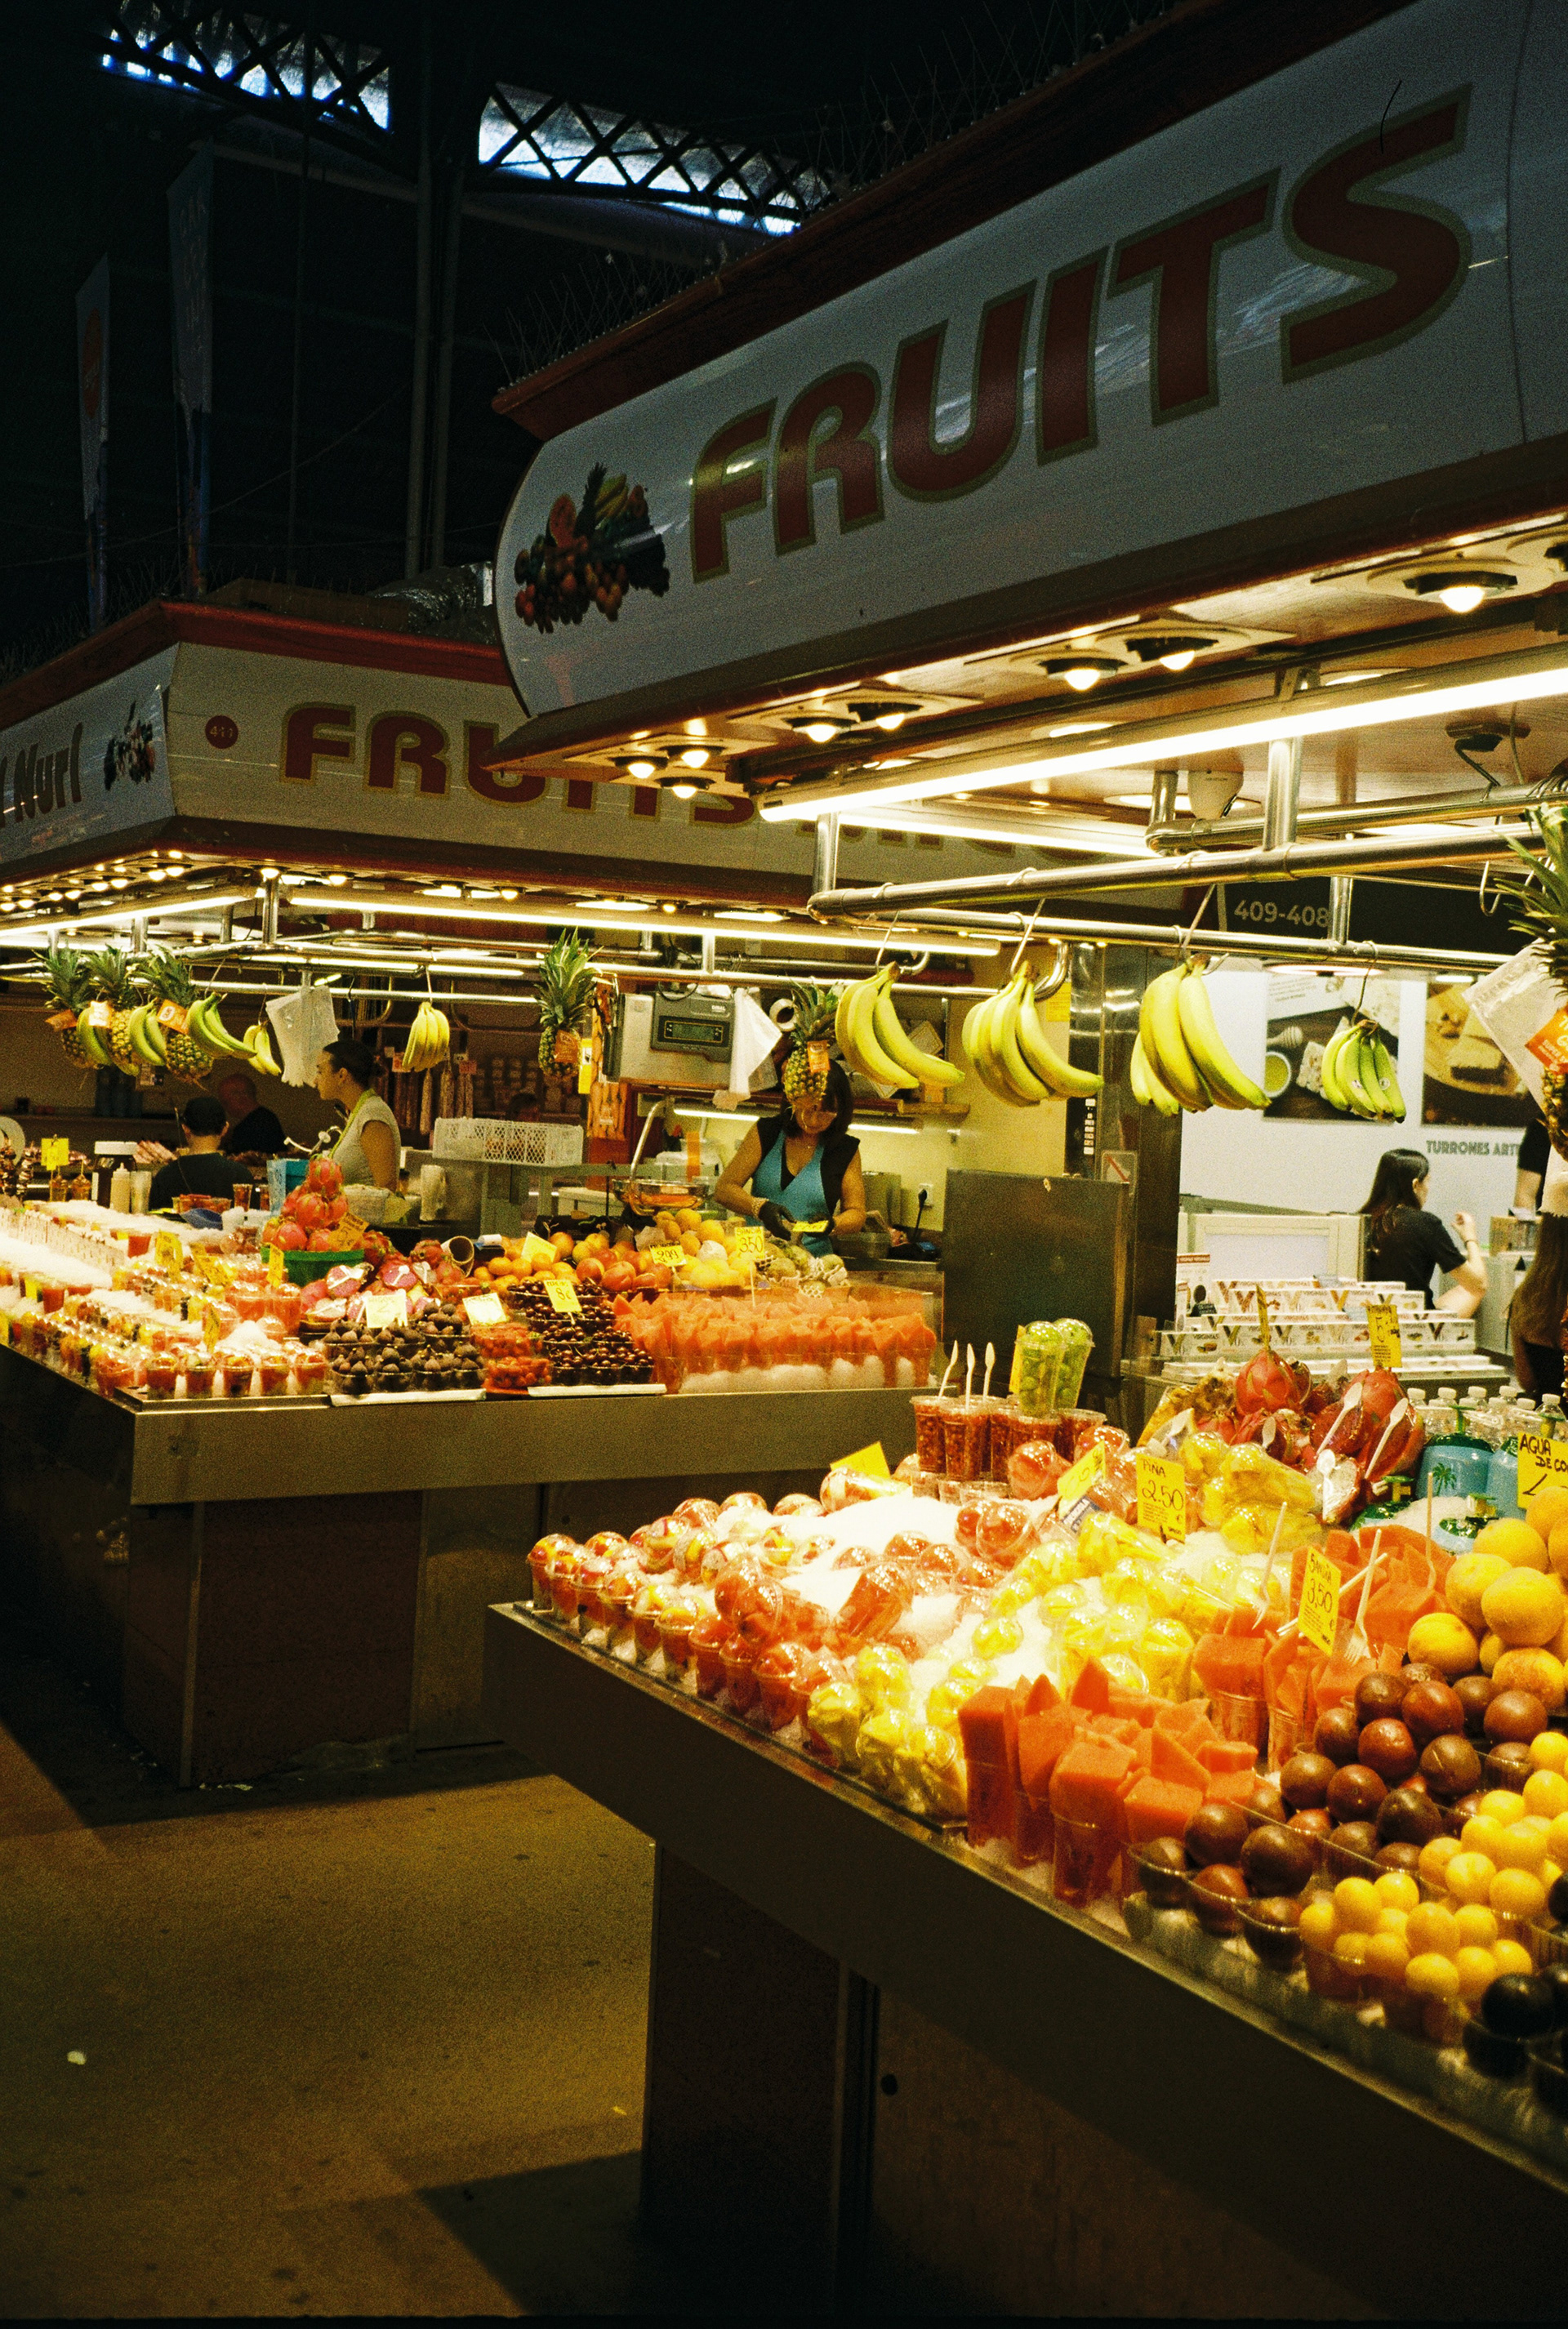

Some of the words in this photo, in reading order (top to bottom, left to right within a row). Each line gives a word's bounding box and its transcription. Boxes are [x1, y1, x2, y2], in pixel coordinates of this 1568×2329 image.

[690, 82, 1474, 583] FRUITS
[1233, 899, 1330, 928] 409-408
[1426, 1140, 1490, 1156] TURRONES
[1519, 1433, 1551, 1456] AGUA
[1535, 1455, 1552, 1469] DE
[1554, 1458, 1568, 1472] CO
[1142, 1479, 1184, 1511] 2.50
